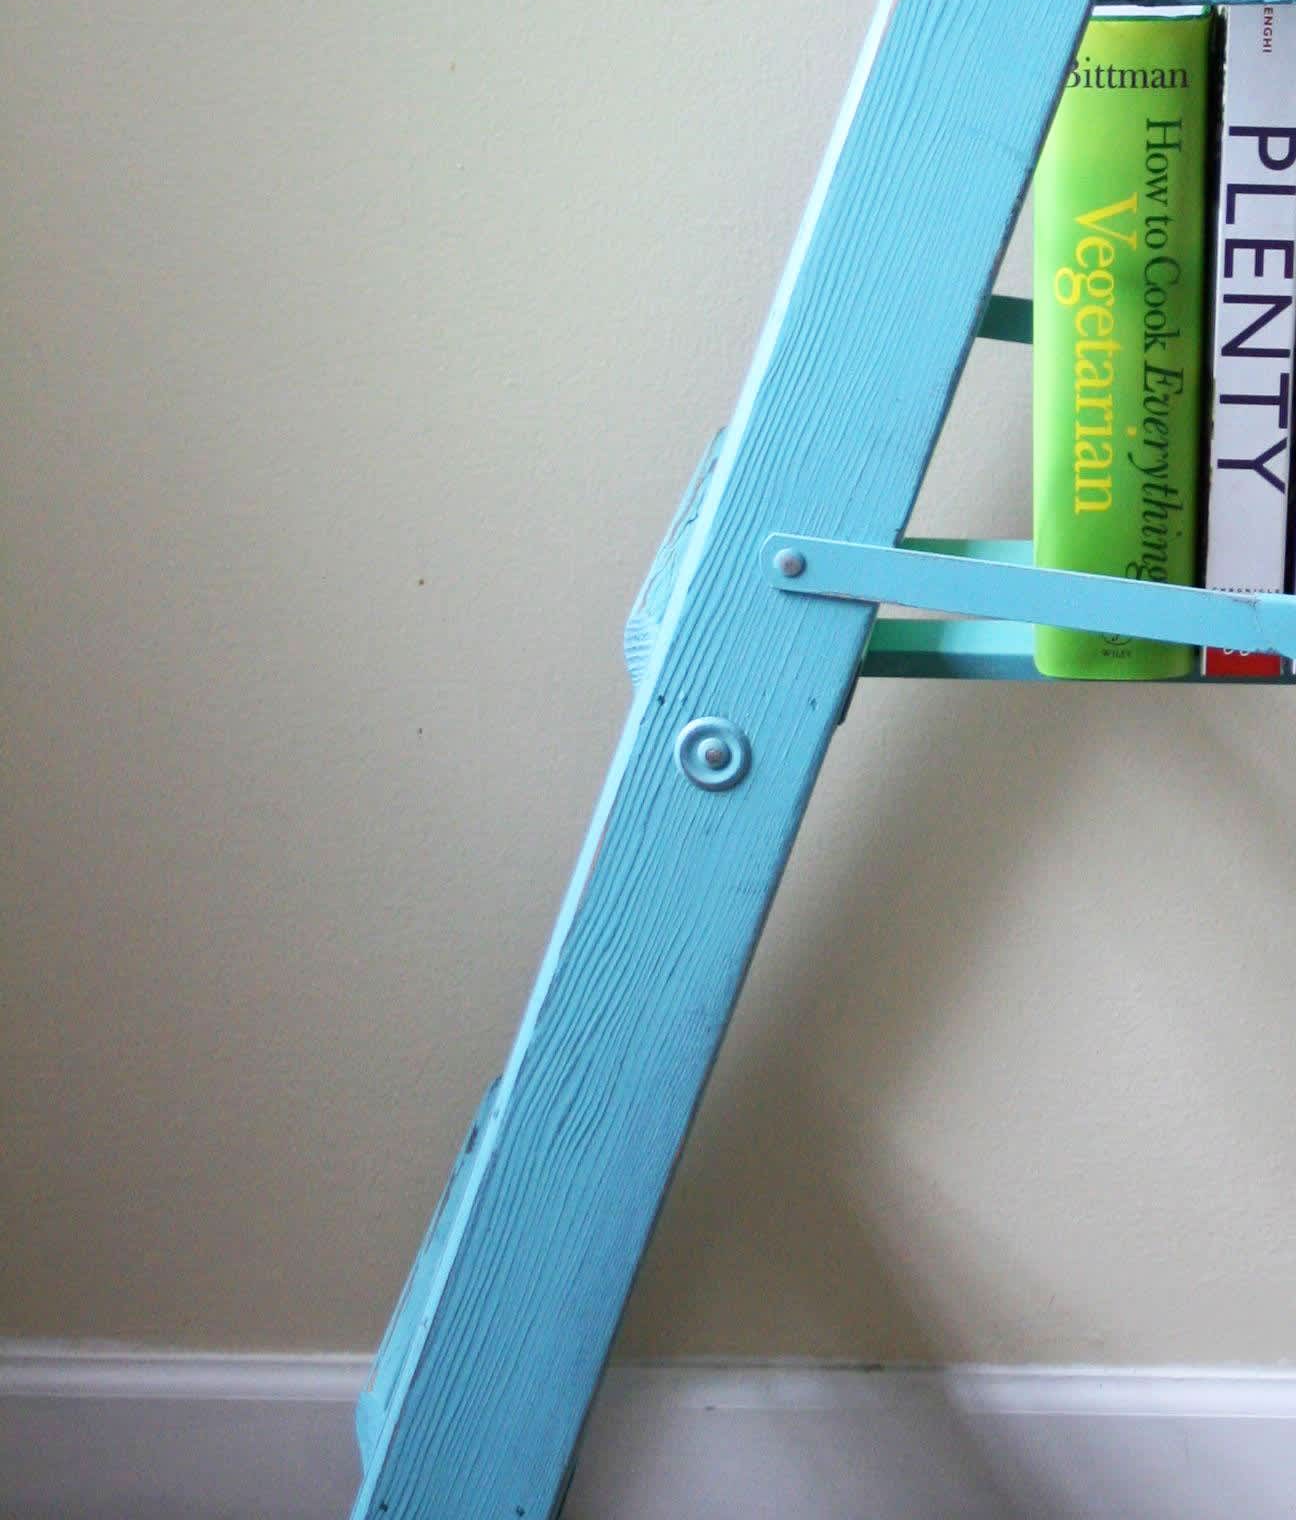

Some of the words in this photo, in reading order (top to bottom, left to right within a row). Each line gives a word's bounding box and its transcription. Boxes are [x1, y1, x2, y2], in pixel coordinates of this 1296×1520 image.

[1262, 3, 1274, 53] ENGHI
[1145, 118, 1182, 208] How
[1144, 216, 1173, 250] to
[1143, 256, 1181, 351] Cook
[1055, 192, 1139, 516] Vegetarian
